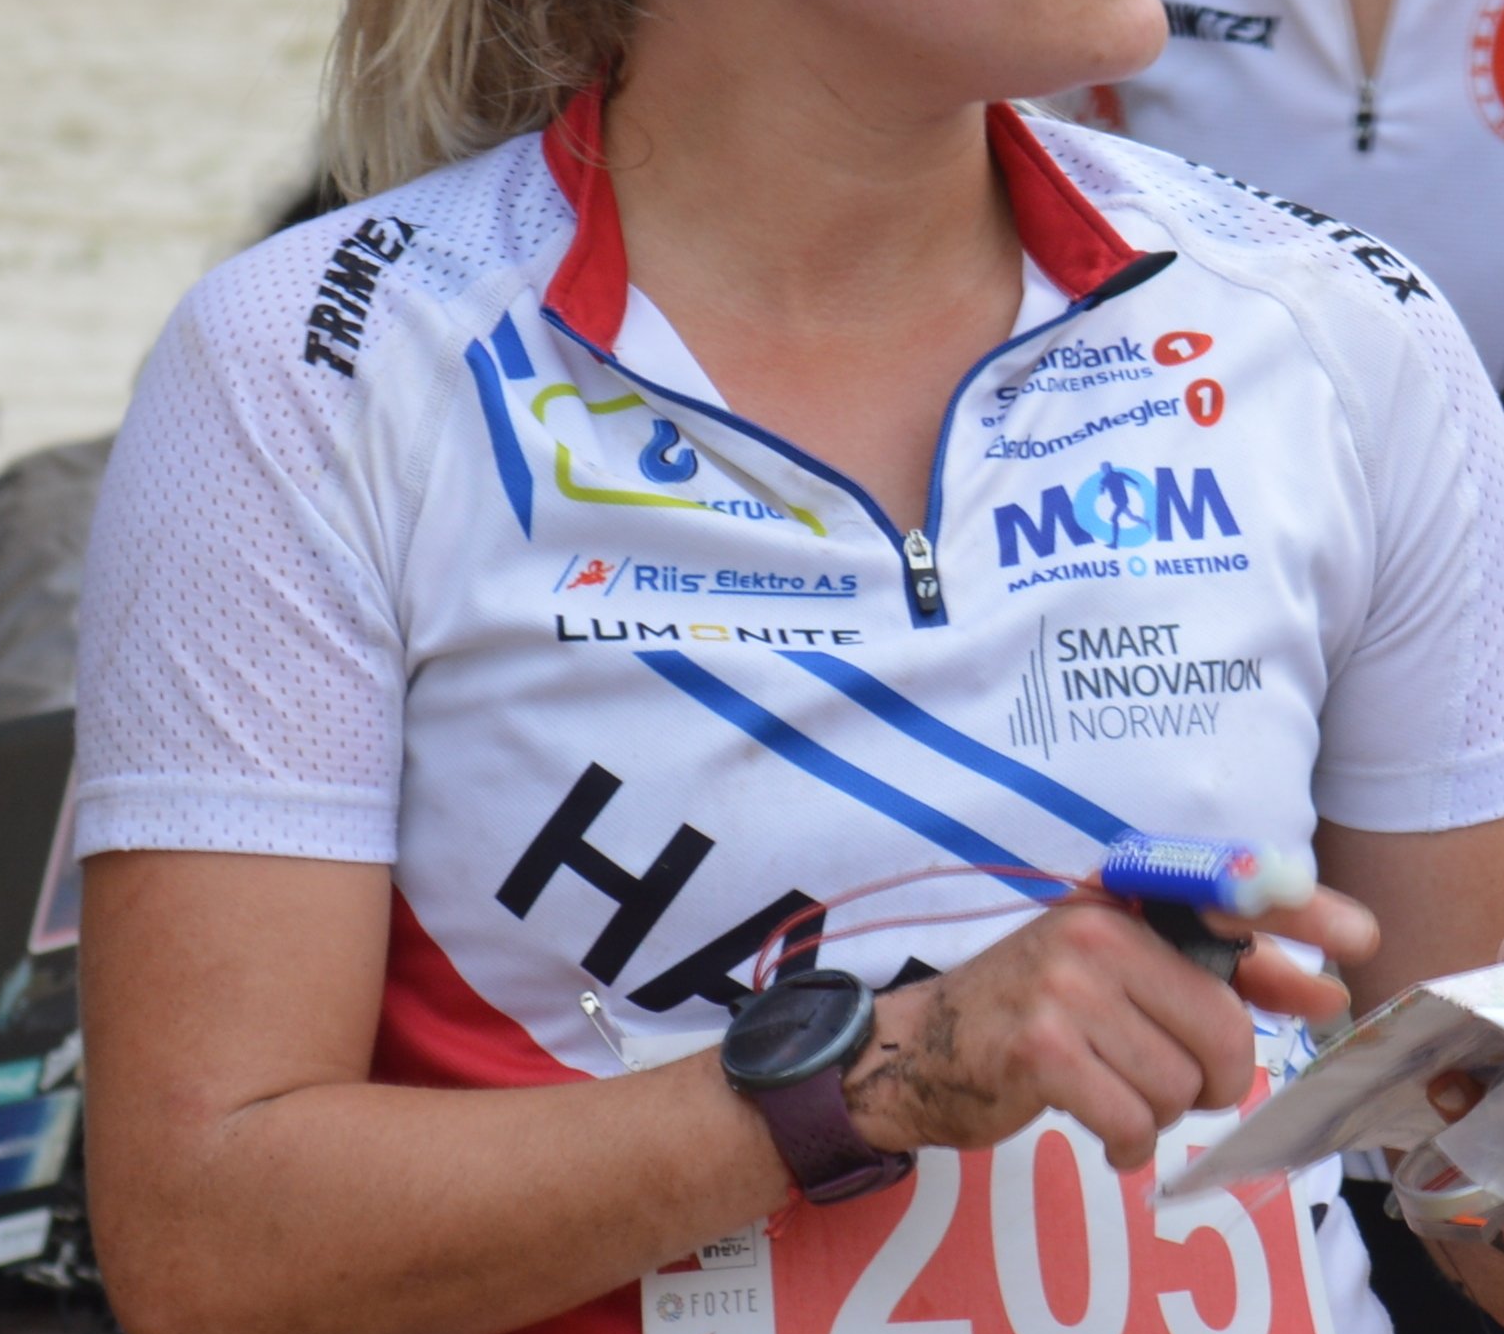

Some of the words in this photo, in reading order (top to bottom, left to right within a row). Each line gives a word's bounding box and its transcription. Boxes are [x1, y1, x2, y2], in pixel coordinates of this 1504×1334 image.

[303, 215, 426, 379] TRIMTEX
[633, 565, 704, 593] Riis
[715, 569, 804, 592] Elektro
[1007, 559, 1121, 594] MAXIMUS
[1154, 553, 1249, 577] MEETING
[555, 614, 864, 646] LUMONITE
[1056, 623, 1180, 664] SMART
[1061, 656, 1263, 701] INNOVATION
[1067, 700, 1220, 743] NORWAY
[495, 762, 943, 1014] HA
